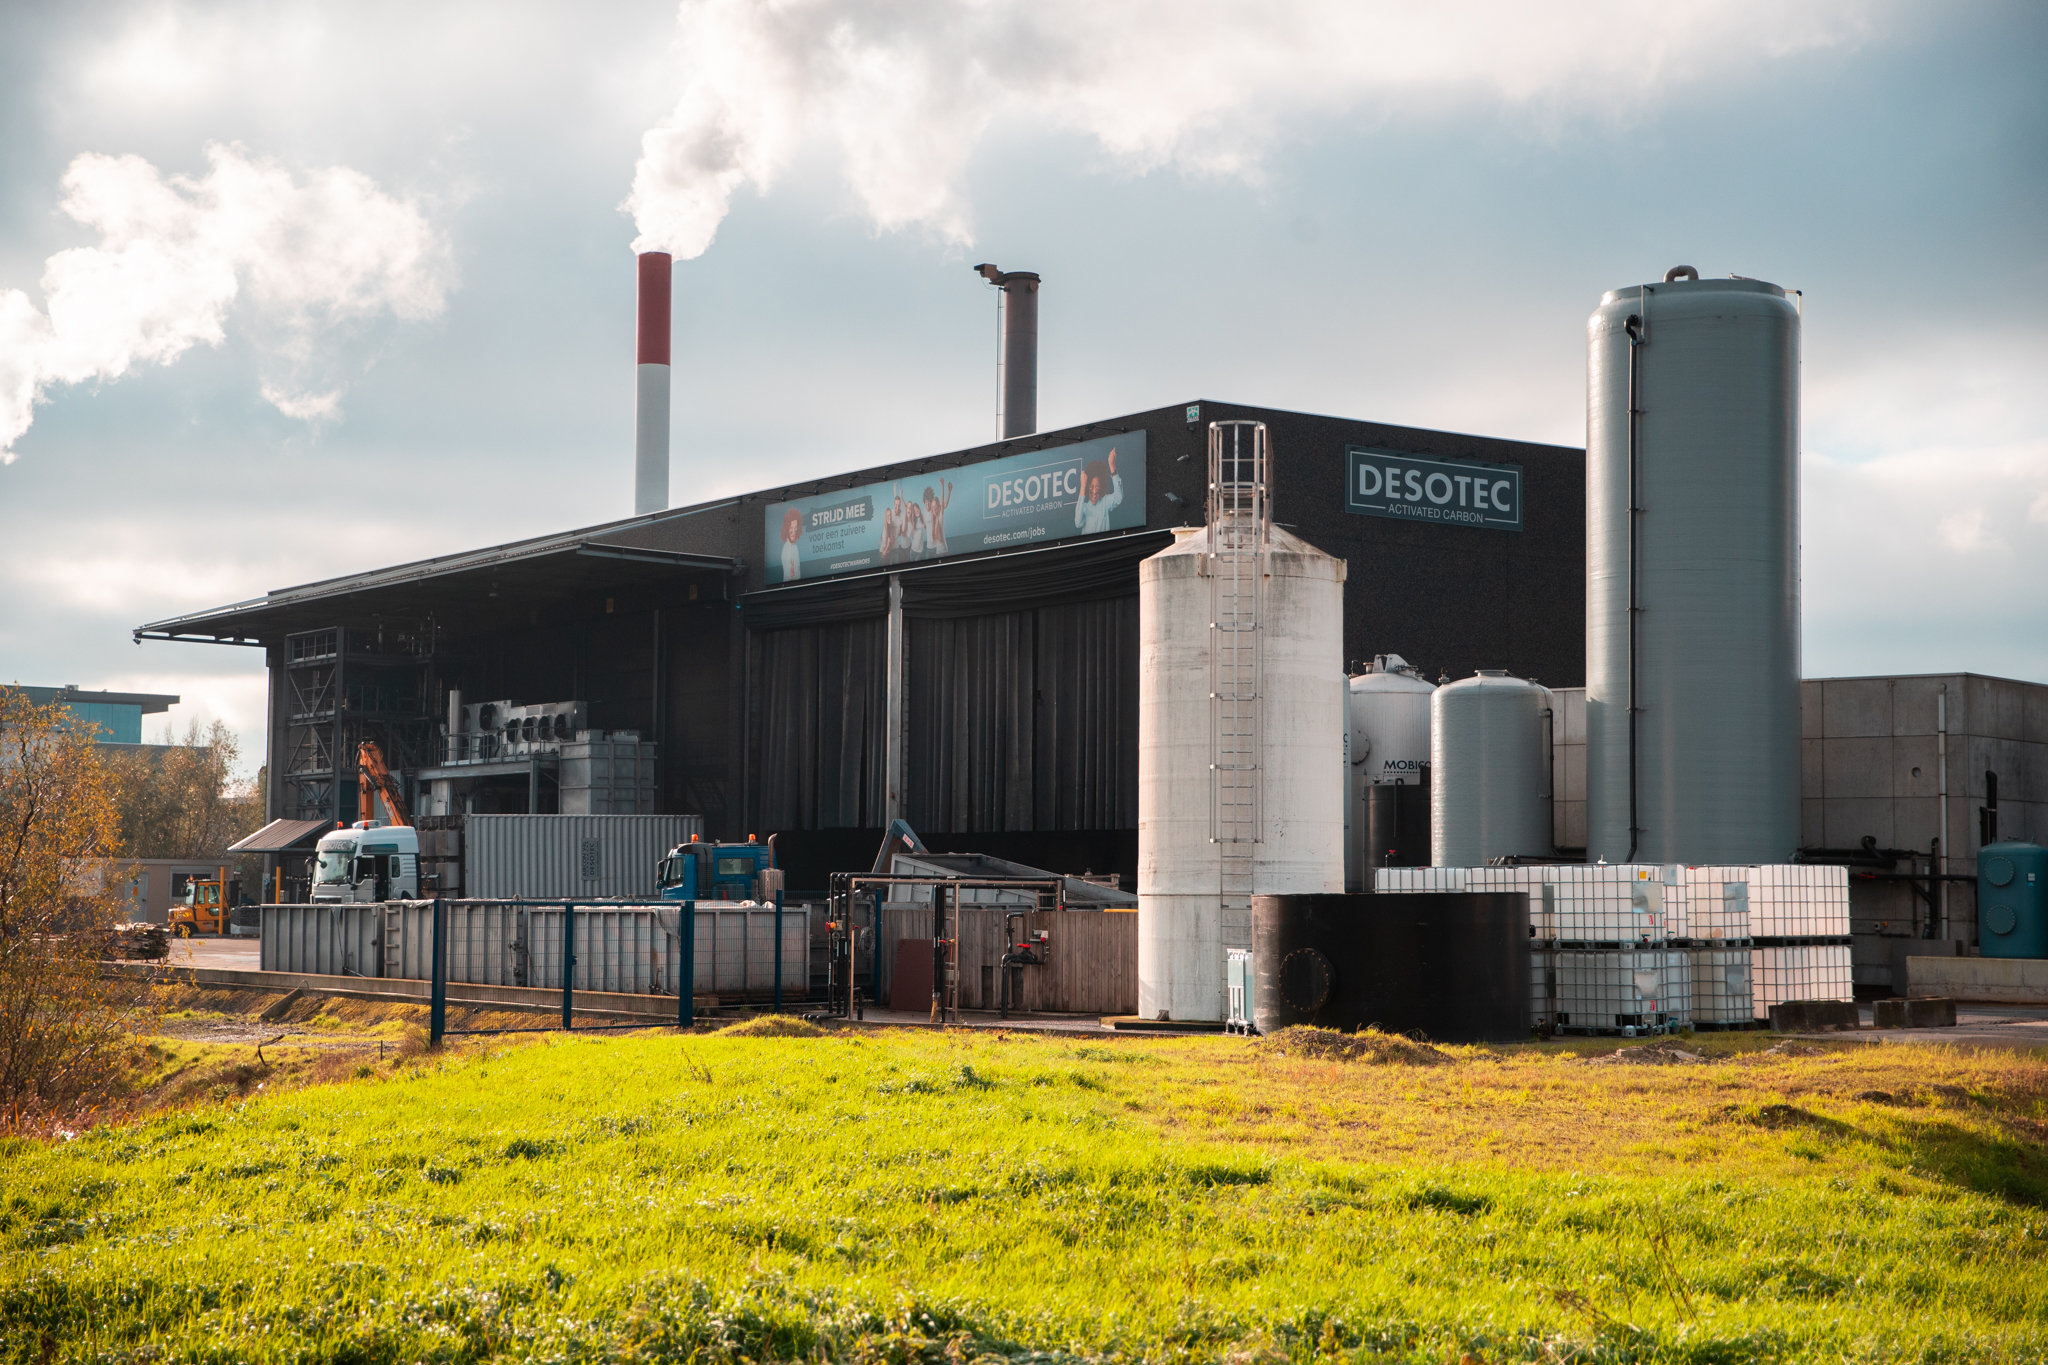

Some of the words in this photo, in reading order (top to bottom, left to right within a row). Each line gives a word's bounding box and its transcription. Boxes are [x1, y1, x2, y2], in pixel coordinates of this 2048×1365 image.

[988, 468, 1077, 509] DESOTEC
[1359, 464, 1511, 512] DESOTEC
[812, 508, 844, 527] STRIJD
[845, 503, 866, 520] MEE
[1002, 505, 1035, 518] ACTIVATED
[1036, 501, 1063, 513] CARBON
[1388, 503, 1441, 519] ACTIVATED
[1443, 509, 1484, 523] CARBON
[809, 532, 825, 542] voor
[825, 530, 839, 540] een
[840, 525, 866, 537] zuivere
[983, 526, 1046, 544] desotec.com/jobs
[812, 540, 845, 554] toekomst
[830, 558, 871, 570] #DESOTECWARRIORS
